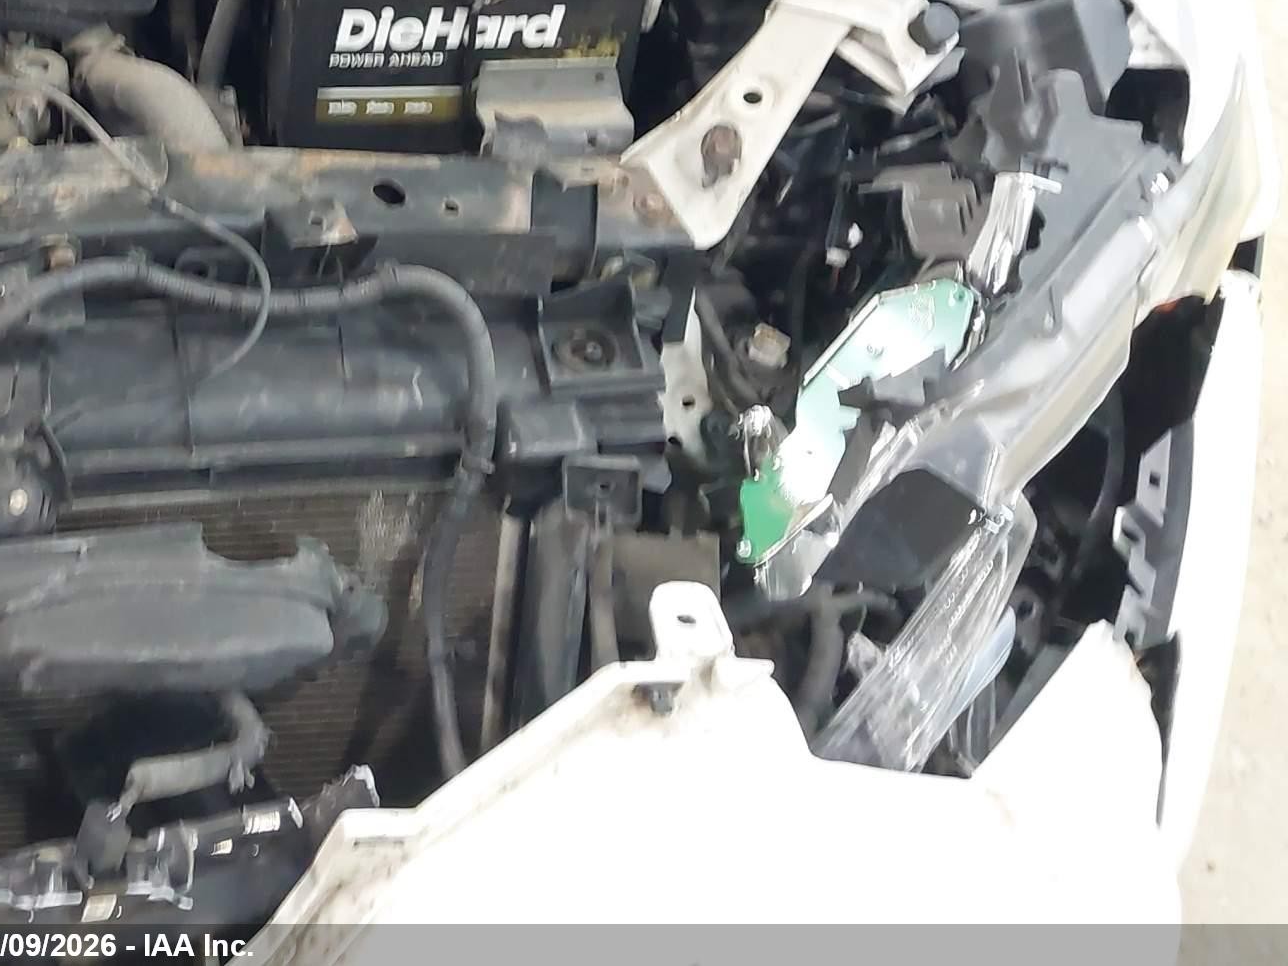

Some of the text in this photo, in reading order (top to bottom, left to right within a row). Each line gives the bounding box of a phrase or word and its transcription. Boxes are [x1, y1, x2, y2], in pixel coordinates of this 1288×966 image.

[335, 4, 566, 52] DieHard
[328, 51, 445, 69] POWER AHEAD
